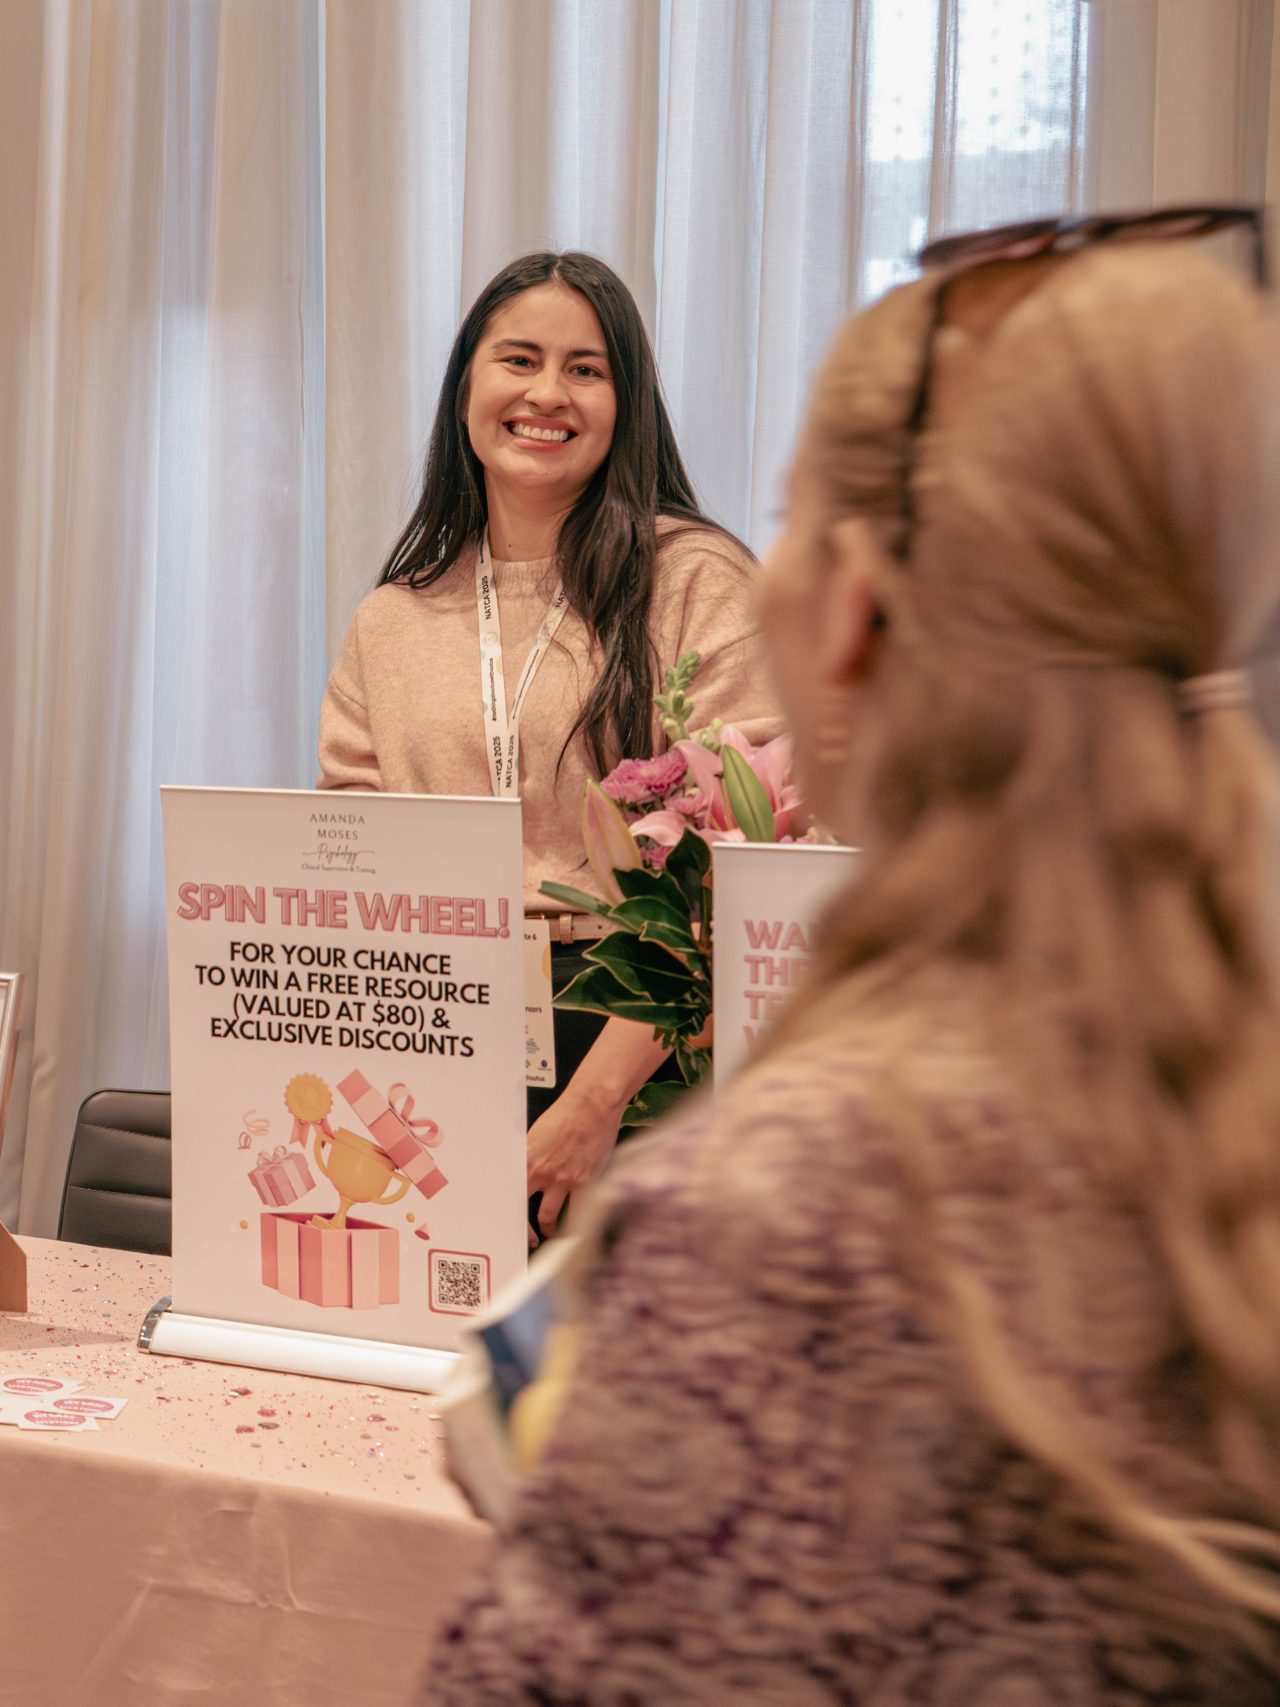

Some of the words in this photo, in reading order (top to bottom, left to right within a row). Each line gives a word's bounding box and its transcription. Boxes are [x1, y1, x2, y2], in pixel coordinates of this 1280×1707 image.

[484, 594, 492, 620] NATCA
[493, 736, 501, 757] 2025
[310, 813, 365, 824] AMANDA
[318, 829, 358, 840] MOSES
[178, 882, 266, 924] SPIN
[273, 887, 348, 929] THE
[354, 892, 511, 939] WHEEL!
[230, 942, 275, 964] FOR
[280, 944, 348, 970] YOUR
[353, 950, 451, 976] CHANCE
[195, 965, 225, 986] TO
[230, 968, 278, 991] WIN
[285, 972, 302, 992] A
[308, 972, 358, 996] FREE
[366, 977, 490, 1006] RESOURCE
[232, 994, 330, 1021] (VALUED
[336, 1000, 366, 1022] AT
[372, 1001, 425, 1032] $80)
[432, 1008, 451, 1030] &
[210, 1018, 332, 1046] EXCLUSIVE
[338, 1028, 474, 1058] DISCOUNTS
